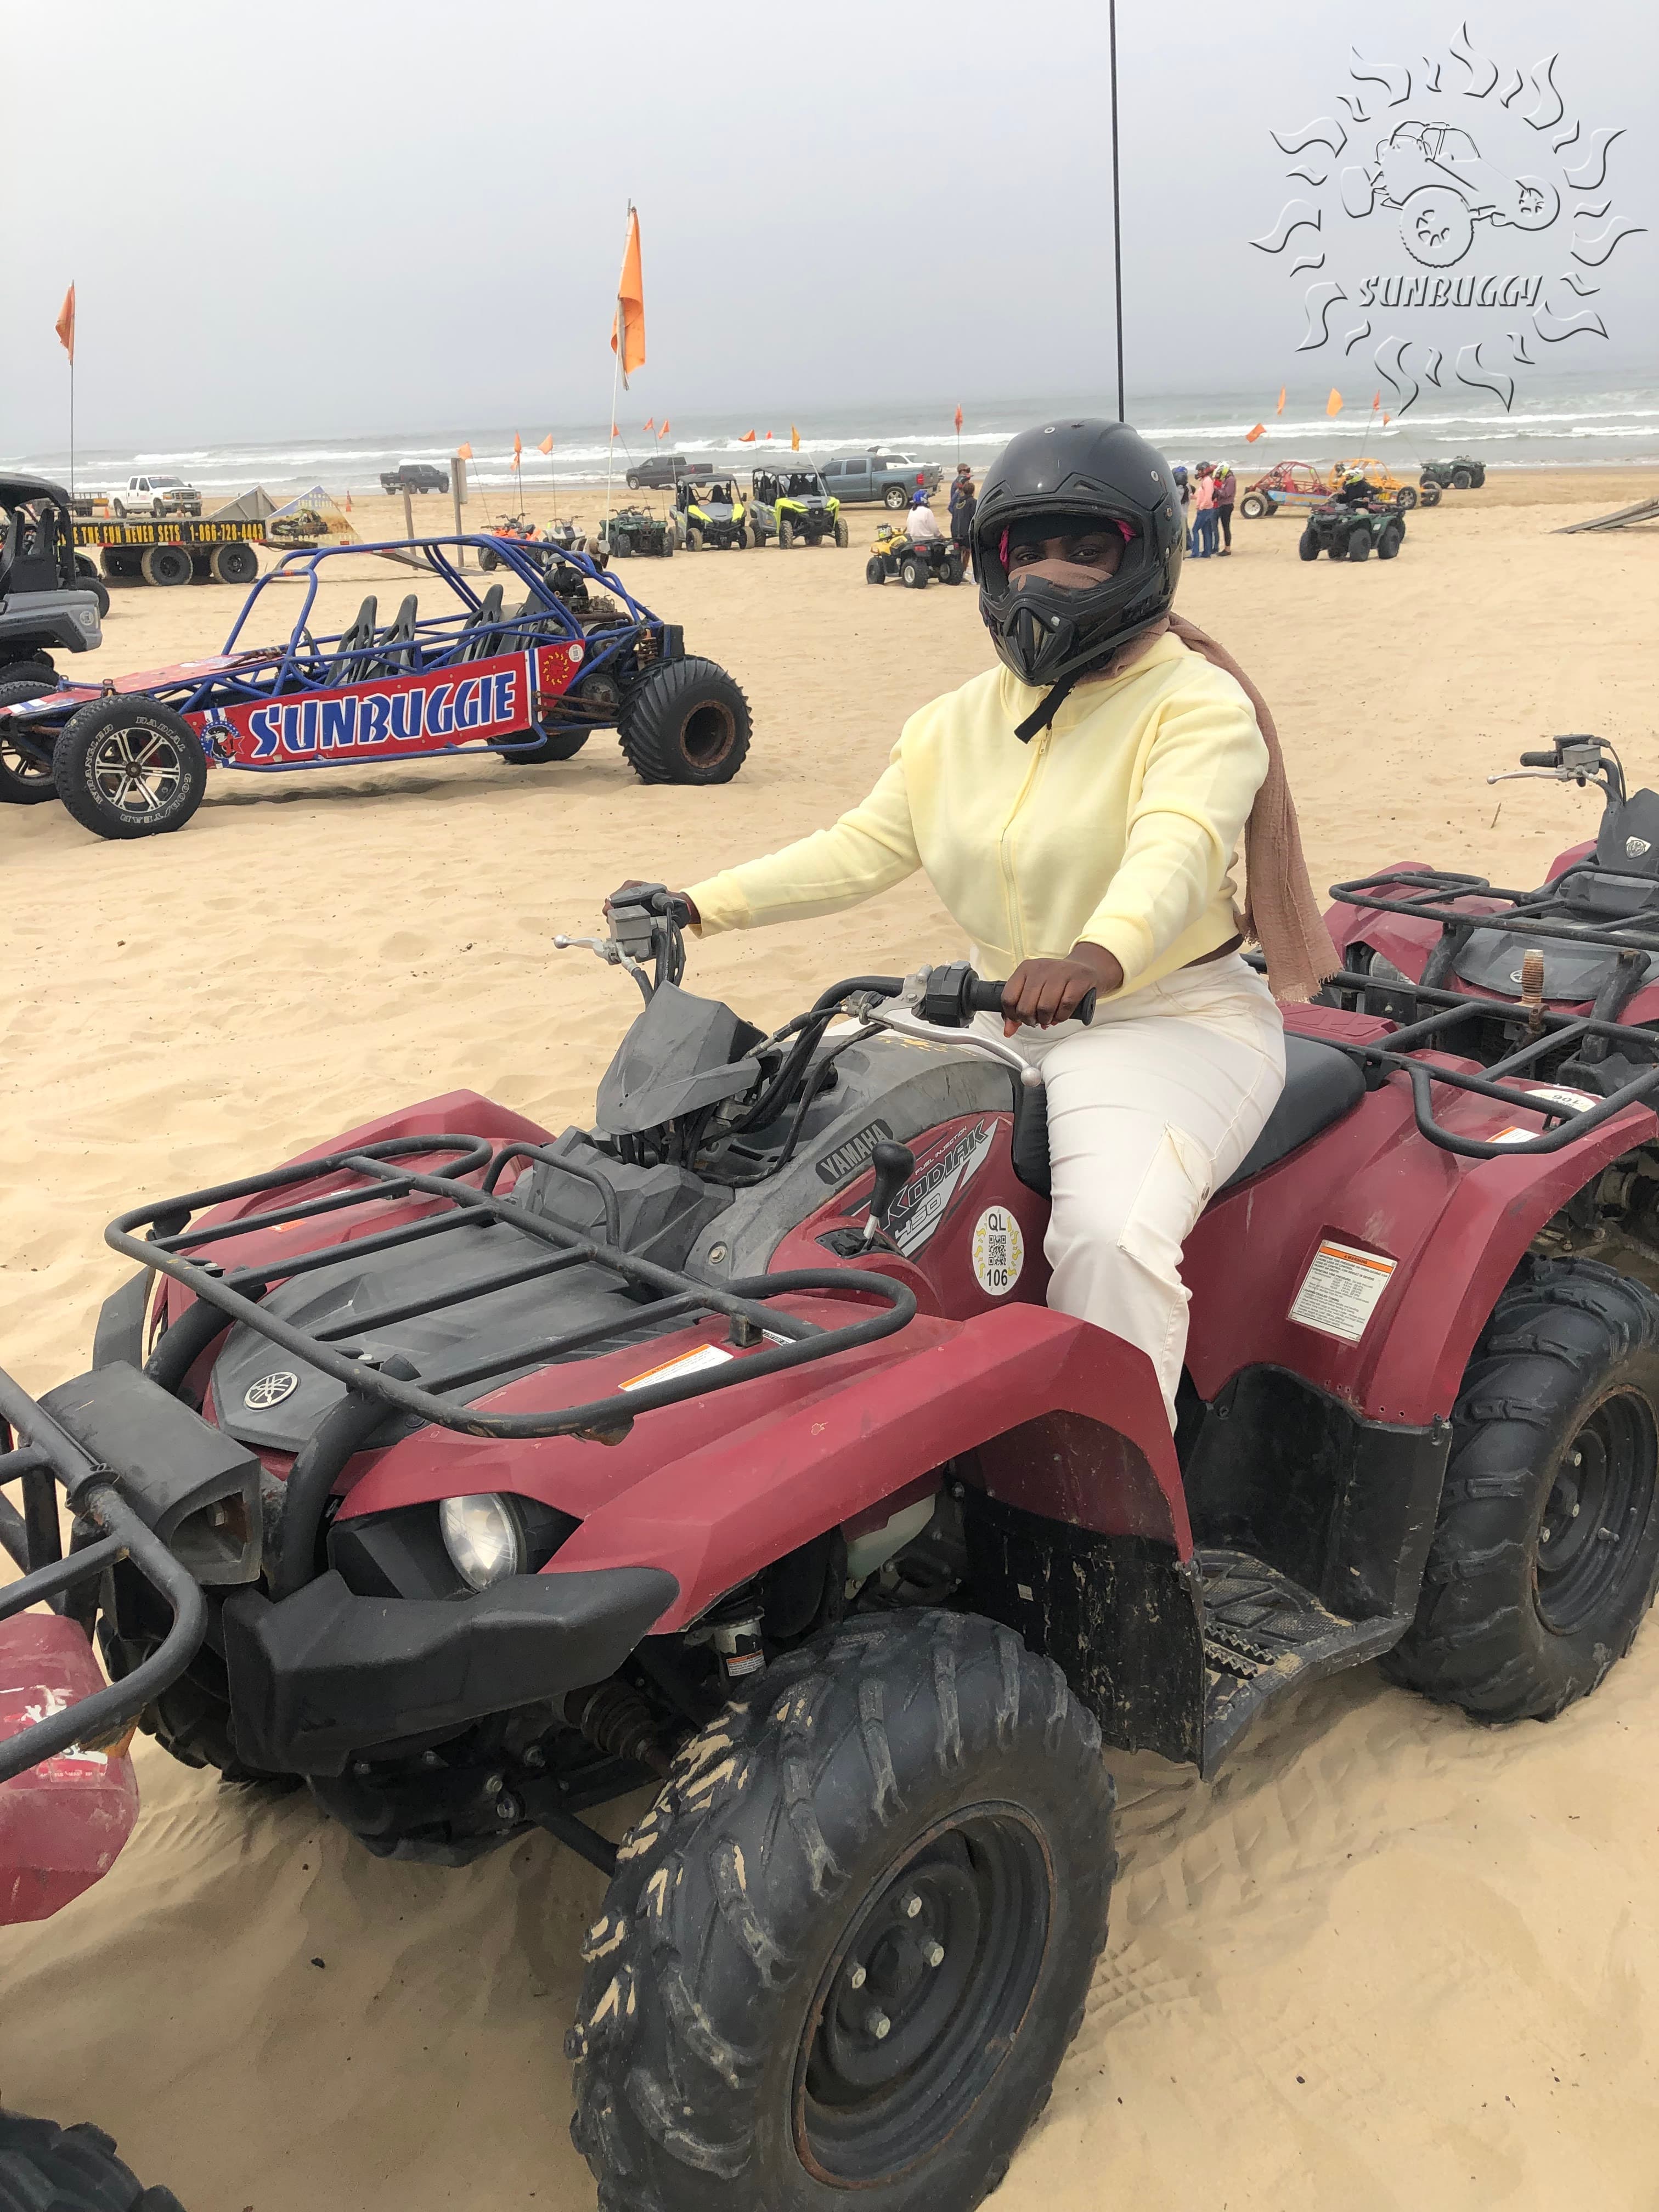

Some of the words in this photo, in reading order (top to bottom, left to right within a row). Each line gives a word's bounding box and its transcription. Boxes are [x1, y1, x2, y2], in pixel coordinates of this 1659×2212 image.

[81, 526, 100, 544] THE
[103, 526, 121, 544] FUN
[125, 525, 154, 543] NEVER
[157, 524, 180, 542] SETS
[190, 524, 263, 541] 1-866-728-4443
[136, 716, 186, 752] RADIAL
[249, 670, 516, 758] SUNBUGGIE
[821, 1124, 889, 1178] YAMAHA
[915, 1158, 934, 1175] FUEL
[935, 1126, 967, 1158] INJECTION
[878, 1118, 988, 1231] KODIAK
[895, 1193, 941, 1239] 450
[989, 1213, 1006, 1232] QL
[987, 1269, 1008, 1286] 106
